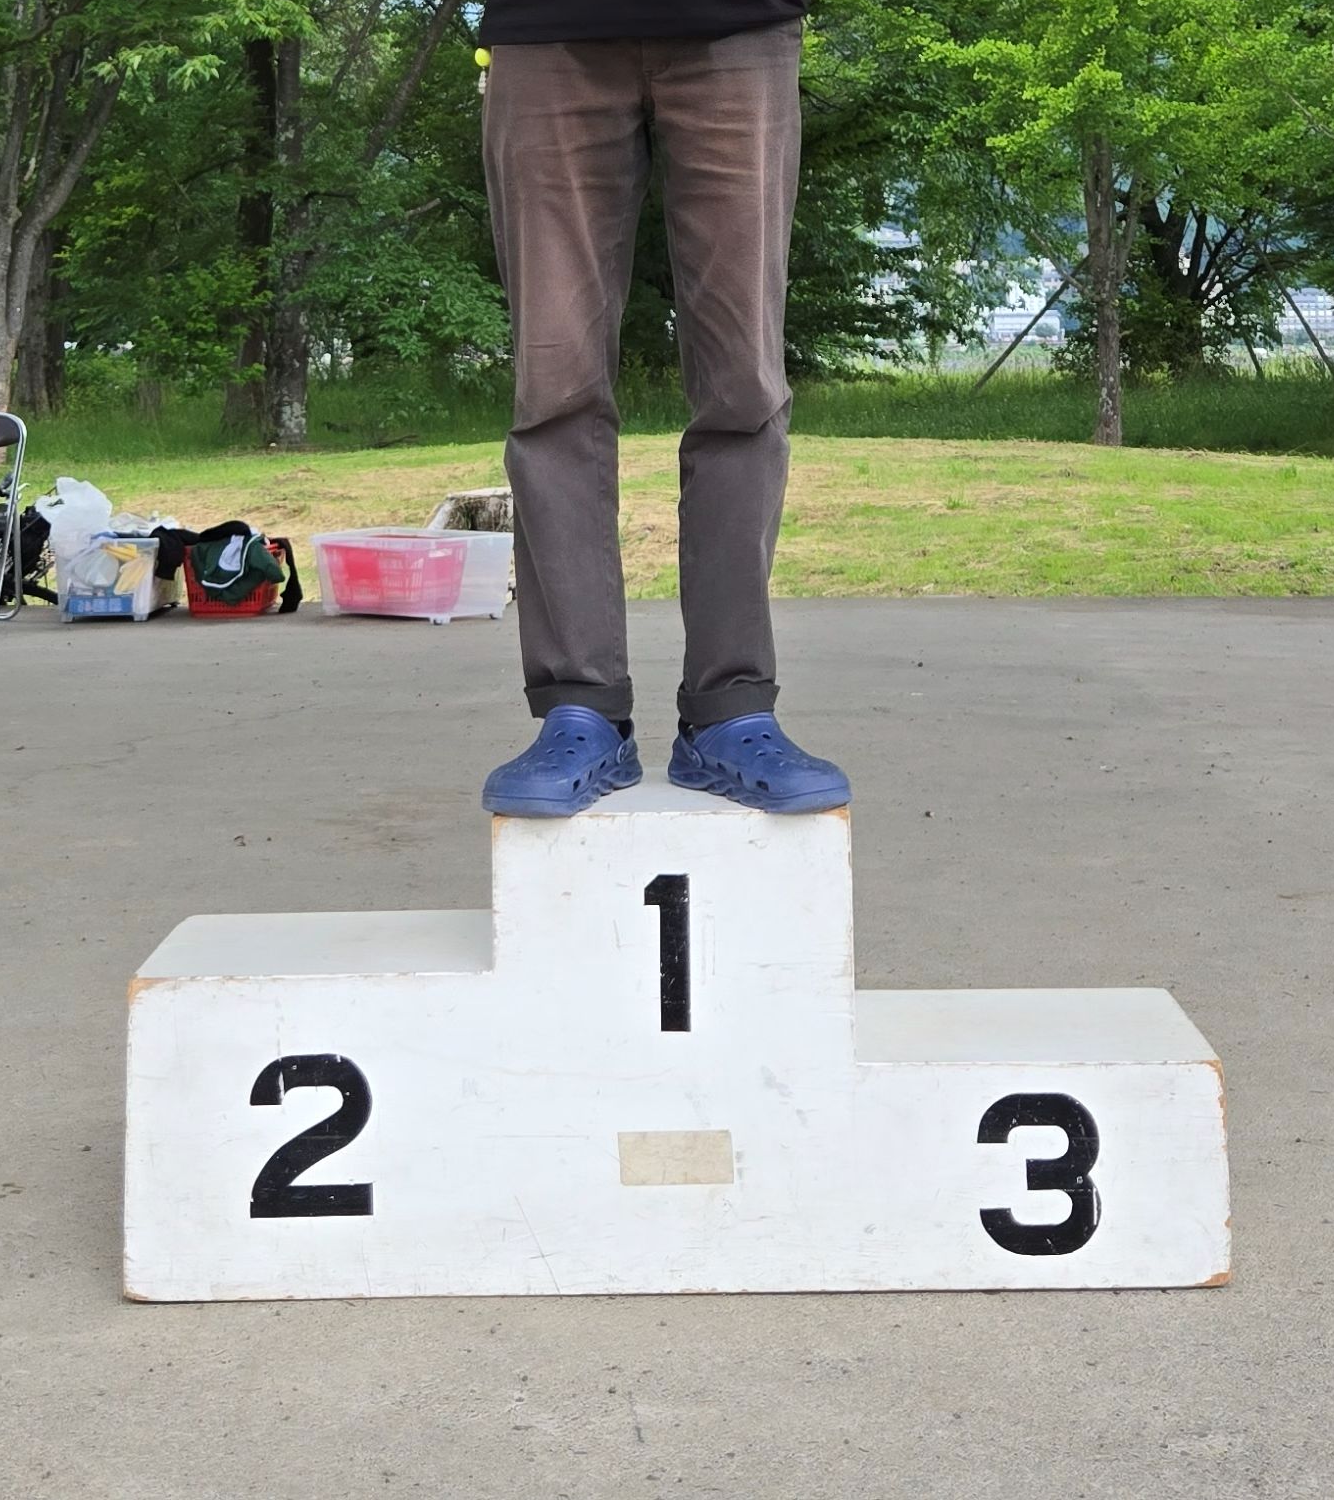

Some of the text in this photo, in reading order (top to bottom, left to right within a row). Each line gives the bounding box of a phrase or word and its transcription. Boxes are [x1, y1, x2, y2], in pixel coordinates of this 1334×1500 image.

[643, 873, 691, 1032] 1
[249, 1053, 374, 1219] 2
[976, 1091, 1103, 1257] 3
